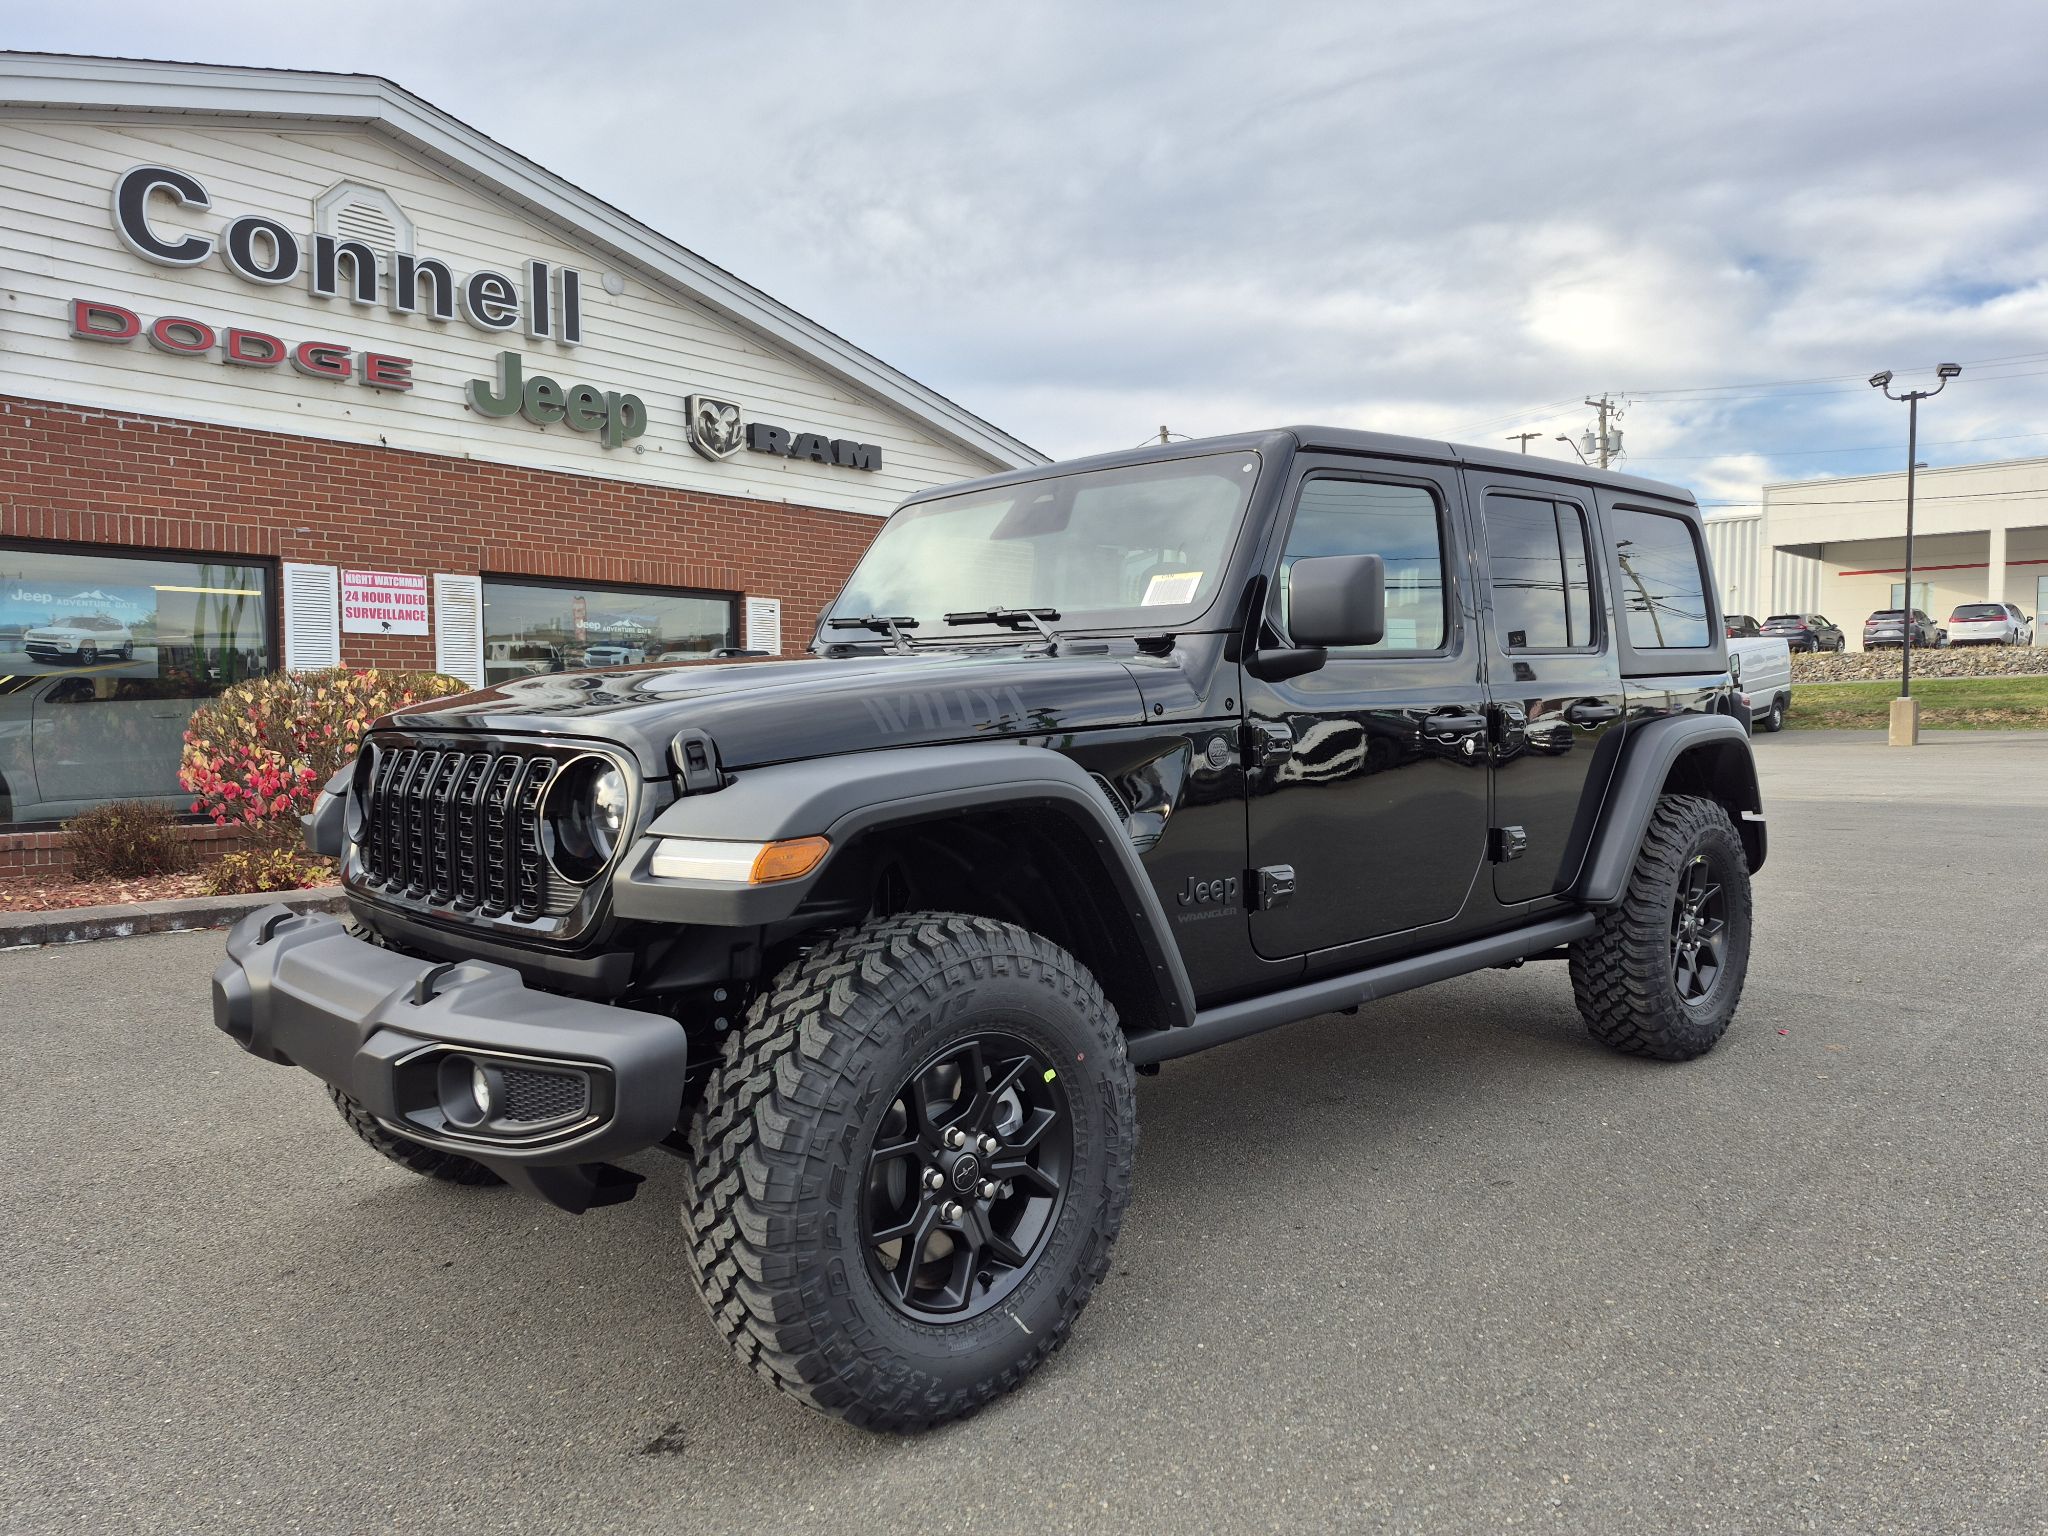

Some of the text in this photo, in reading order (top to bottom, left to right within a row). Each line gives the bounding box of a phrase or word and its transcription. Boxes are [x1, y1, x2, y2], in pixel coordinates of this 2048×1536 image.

[111, 163, 582, 347] Connell
[68, 297, 413, 391] DODGE
[465, 351, 648, 450] Jeep
[746, 422, 883, 472] RAM
[345, 573, 424, 588] NIGHT WATCHMAN
[11, 588, 138, 609] Jeep ADVENTURE DAYS
[345, 590, 425, 606] 24 HOUR VIDEO
[345, 606, 426, 621] SURVEILLANCE
[576, 619, 601, 630] Jeep
[1177, 876, 1239, 907] Jeep
[1177, 907, 1237, 923] WRANGLER
